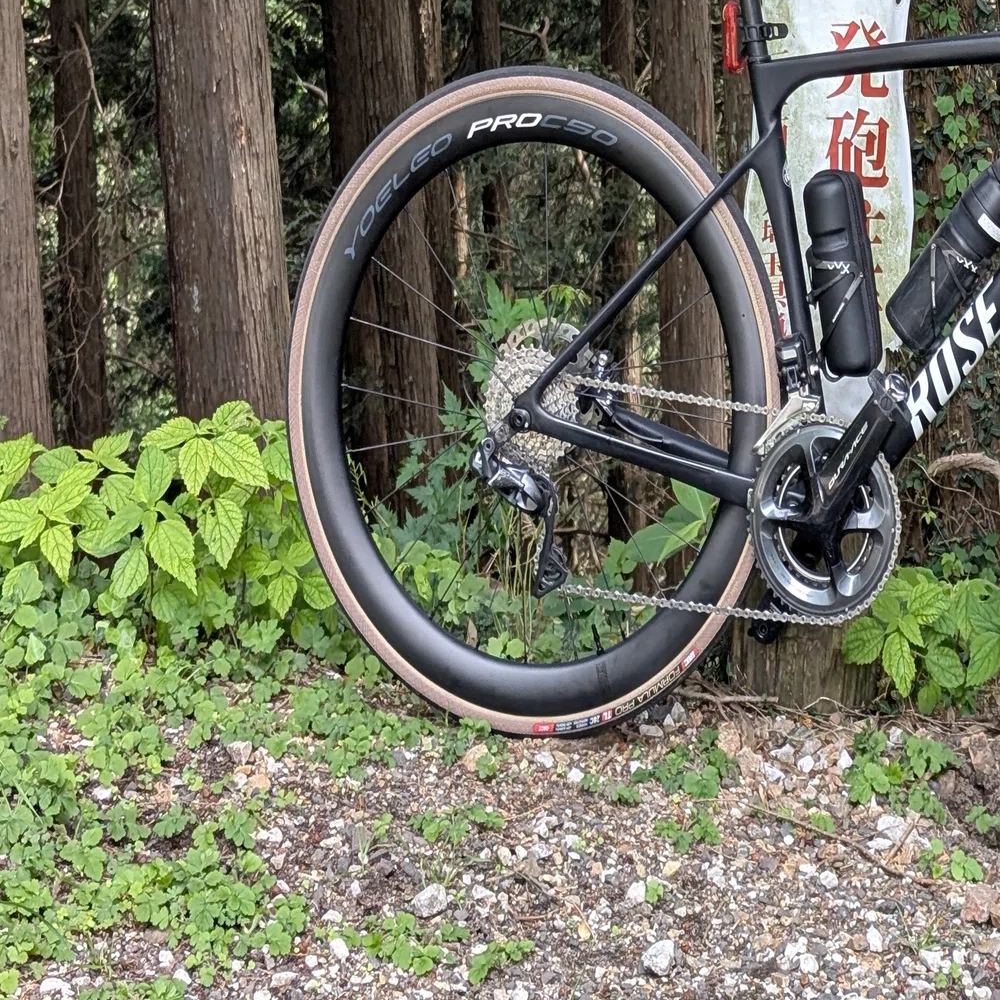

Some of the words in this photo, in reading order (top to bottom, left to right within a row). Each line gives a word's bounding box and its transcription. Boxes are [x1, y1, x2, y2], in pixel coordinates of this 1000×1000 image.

[343, 132, 454, 261] YOELEO
[825, 19, 890, 312] 発砲
[614, 702, 636, 716] PRO
[638, 664, 681, 704] FORMULA
